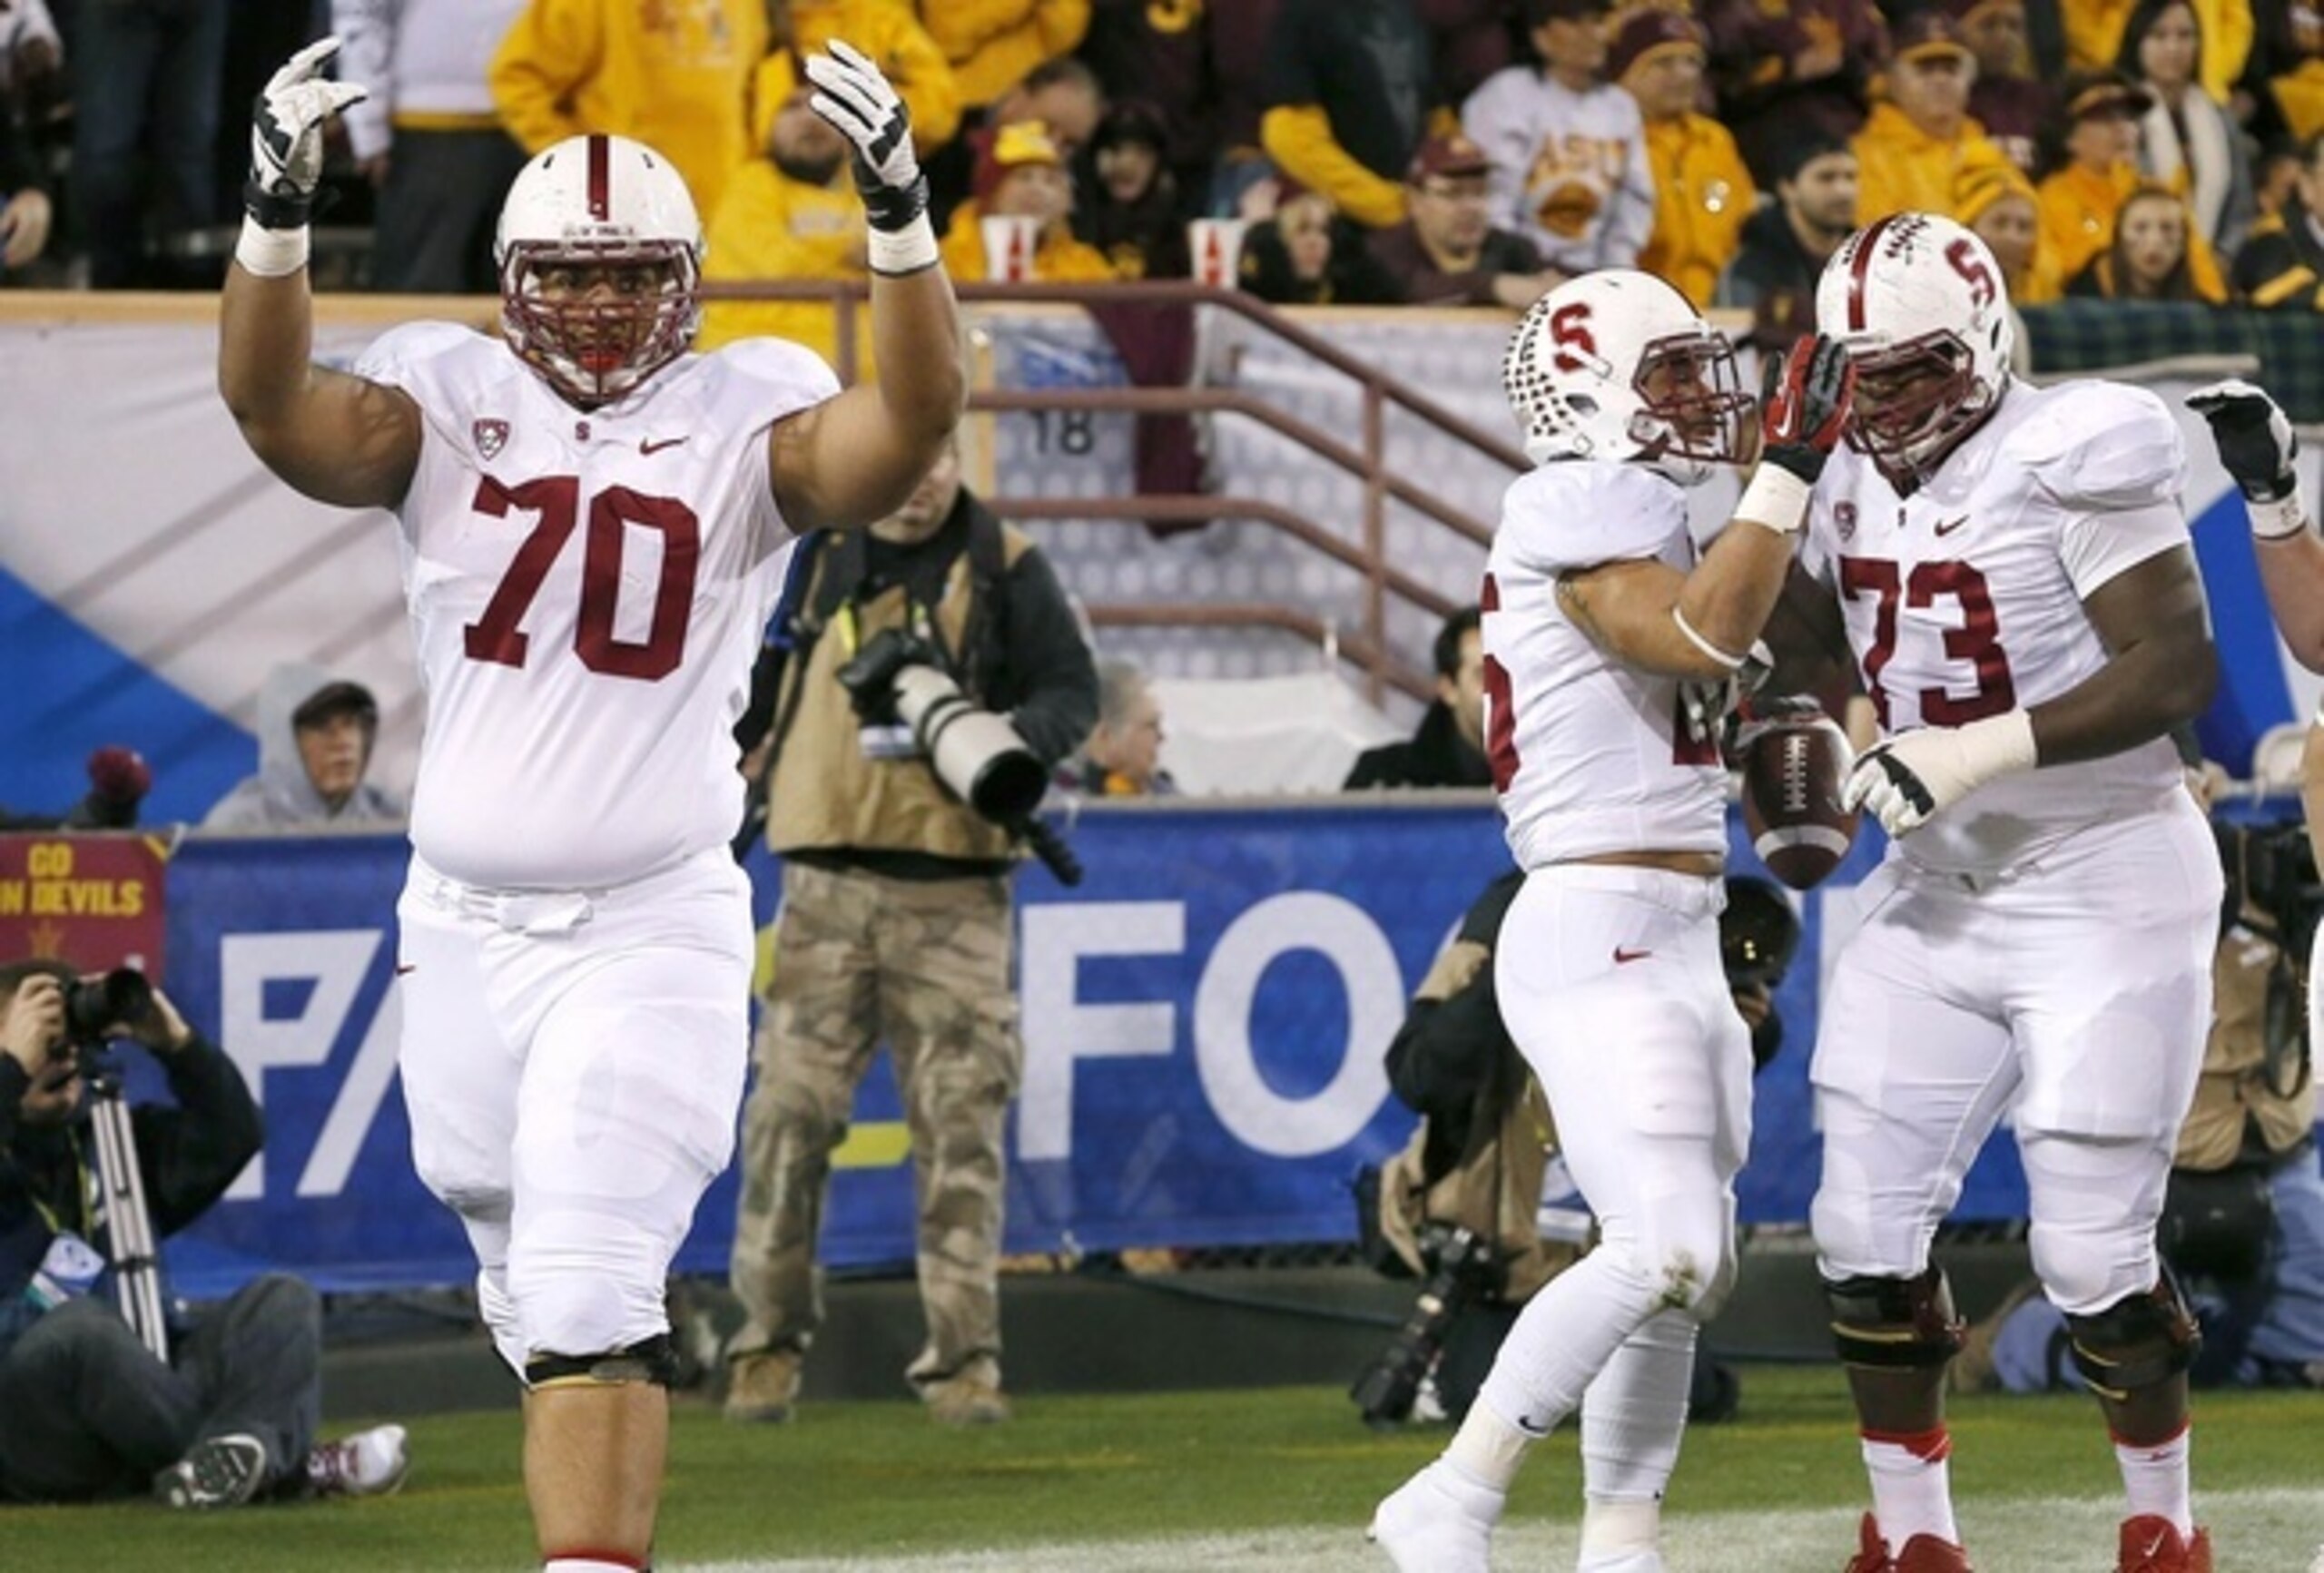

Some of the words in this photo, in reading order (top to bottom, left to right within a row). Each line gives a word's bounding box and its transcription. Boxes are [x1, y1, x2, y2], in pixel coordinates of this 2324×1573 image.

[1551, 301, 1596, 373] S
[1029, 408, 1096, 457] 18
[464, 472, 701, 683] 70
[1838, 554, 2016, 732] 73
[28, 842, 73, 878] GO
[31, 879, 143, 917] DEVILS
[1018, 890, 1466, 1160] FO
